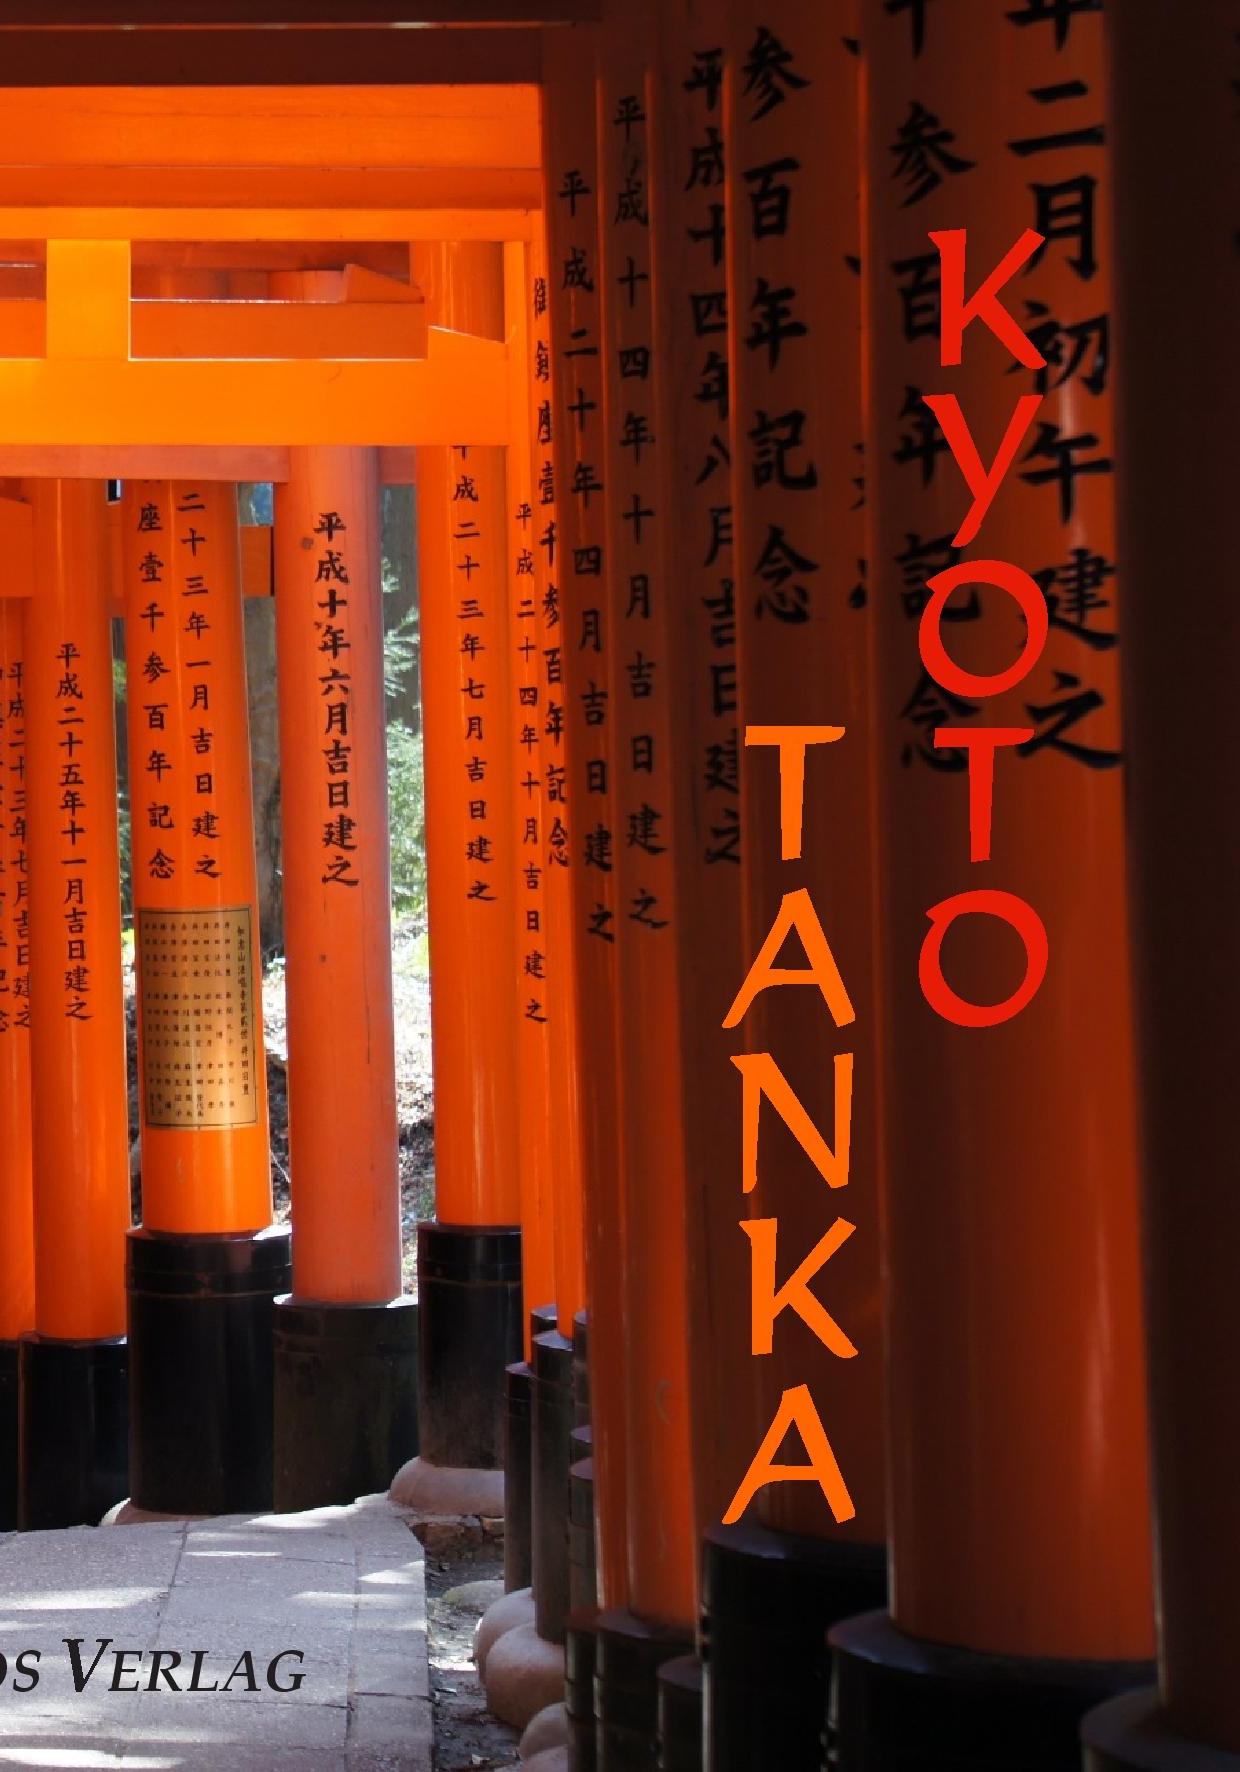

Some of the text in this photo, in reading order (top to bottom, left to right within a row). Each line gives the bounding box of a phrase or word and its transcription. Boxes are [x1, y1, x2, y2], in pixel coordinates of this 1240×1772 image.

[176, 493, 223, 881] 二十三年一月吉日建之
[312, 511, 360, 888] 平成十年六月吉日建之
[559, 168, 616, 943] 平成二十年四月吉日建之
[54, 642, 92, 1022] 平成二十五年十一月吉日建之
[515, 503, 549, 1024] 平成二十四年十月吉日建之
